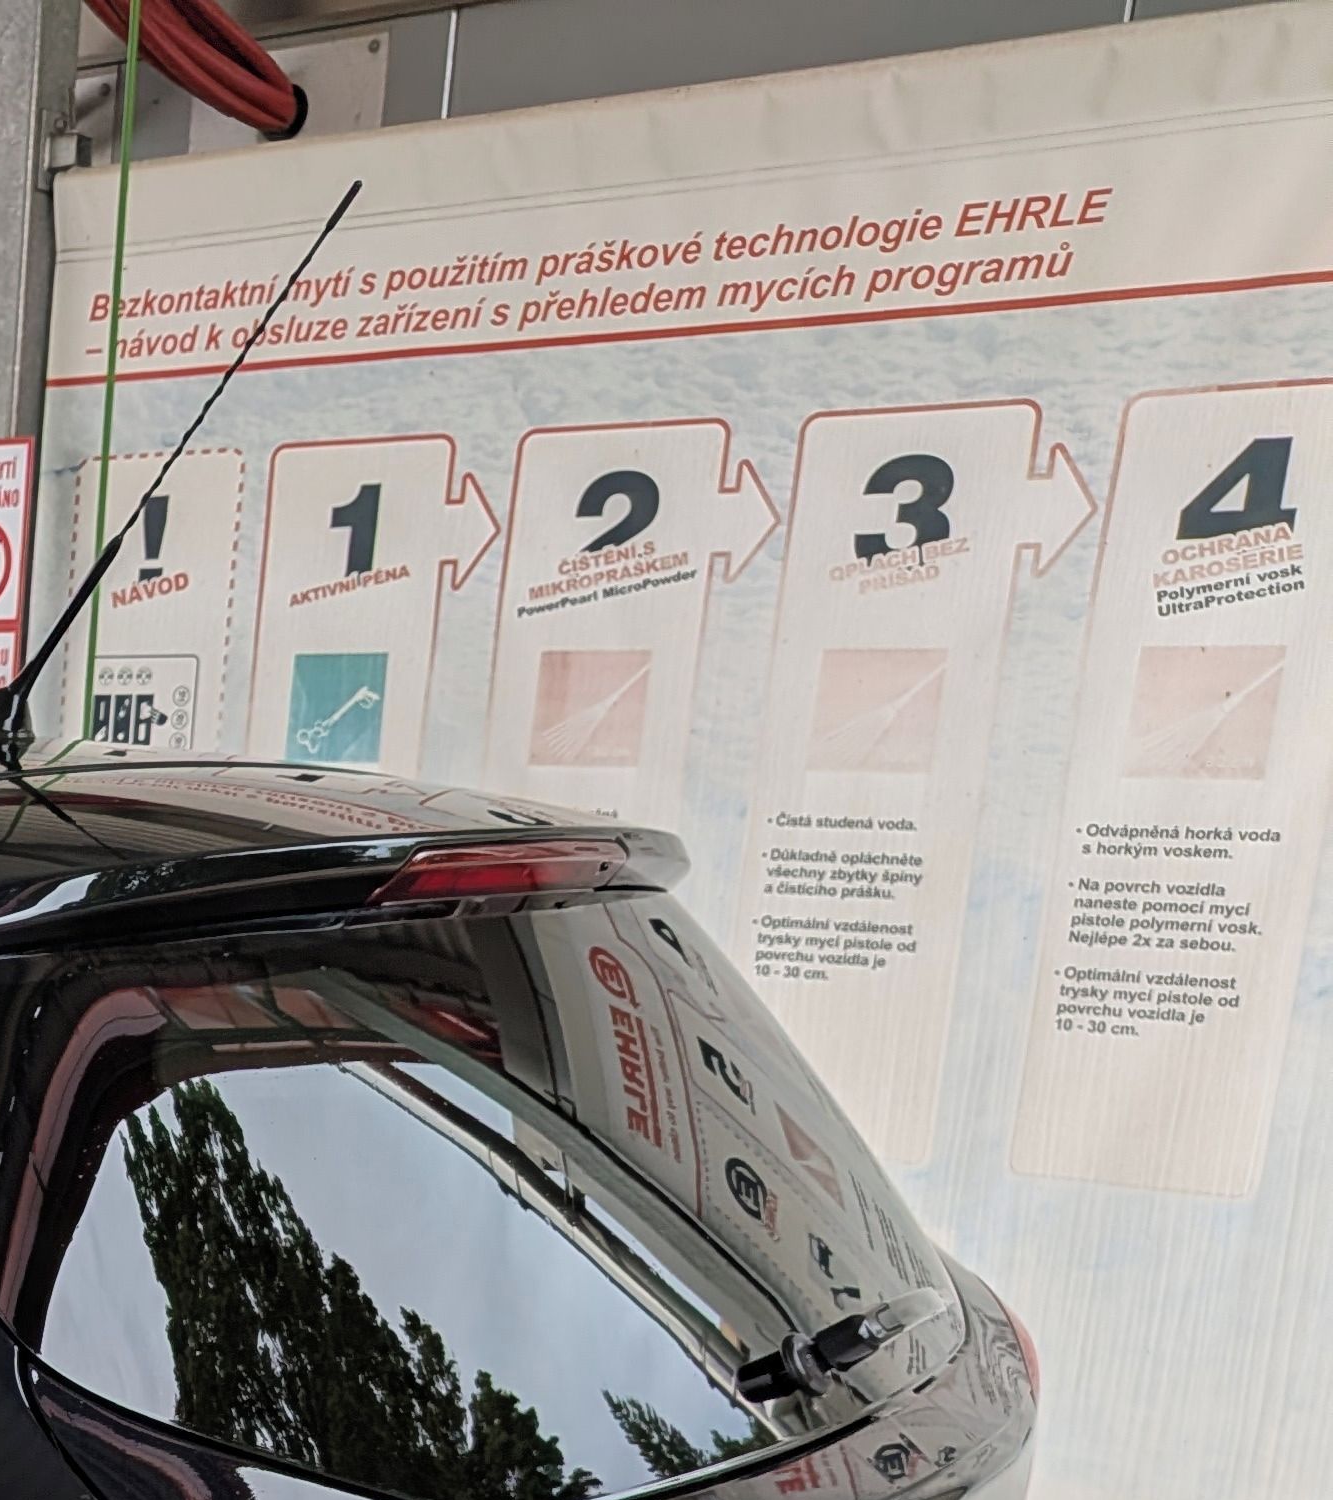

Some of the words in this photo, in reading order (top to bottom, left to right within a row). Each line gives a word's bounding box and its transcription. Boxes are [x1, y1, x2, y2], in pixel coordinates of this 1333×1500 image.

[89, 274, 279, 322] Bezkontaktní
[290, 266, 351, 309] mytí
[359, 271, 376, 296] s
[384, 251, 529, 300] použitím
[536, 231, 704, 291] práškové
[713, 207, 943, 262] technologie
[954, 188, 1113, 238] EHRLE
[116, 324, 200, 359] návod
[205, 323, 224, 351] k
[356, 297, 484, 338] zařízení
[490, 306, 509, 326] s
[518, 278, 707, 331] přehledem
[717, 263, 856, 313] mycích
[864, 240, 1075, 303] programů
[1176, 436, 1297, 540] 4
[576, 470, 660, 552] 2
[853, 454, 954, 566] 3
[329, 483, 381, 579] 1
[643, 541, 656, 556] S
[924, 537, 970, 559] BEZ
[1161, 525, 1292, 565] OCHRANA
[517, 590, 599, 618] PowerPearl
[602, 568, 698, 600] MicroPowder
[1156, 572, 1251, 602] Polymerní
[1257, 564, 1303, 582] vosk
[1157, 580, 1305, 617] UltraProtection
[775, 812, 812, 827] Čistá
[816, 815, 873, 830] studená
[877, 817, 918, 831] voda.
[1085, 823, 1180, 841] Odvápněná
[1184, 826, 1233, 841] horká
[1238, 828, 1281, 842] voda
[770, 848, 837, 863] Důkladně
[841, 852, 923, 867] opláchněte
[1081, 842, 1092, 855] s
[1096, 841, 1158, 859] horkým
[1163, 844, 1234, 860] voskem.
[766, 866, 825, 882] všechny
[829, 869, 877, 884] zbytky
[764, 883, 773, 894] a
[1077, 878, 1100, 891] Na
[1104, 880, 1161, 895] povrch
[1166, 882, 1226, 897] vozidla
[1073, 897, 1137, 910] naneste
[1141, 900, 1205, 915] pomocí
[1208, 902, 1251, 918] mycí
[761, 915, 830, 931] Optimální
[833, 919, 913, 936] vzdálenost
[1070, 912, 1125, 928] pistole
[1129, 916, 1213, 932] polymerní
[1217, 921, 1263, 935] vosk.
[757, 932, 801, 948] trysky
[805, 935, 840, 950] mycí
[843, 936, 892, 952] pistole
[897, 940, 917, 953] od
[1068, 930, 1128, 948] Nejlépe
[1133, 933, 1151, 947] 2x
[1155, 937, 1174, 949] za
[1179, 938, 1236, 952] sebou.
[755, 950, 814, 964] povrchu
[818, 951, 869, 966] vozidla
[872, 954, 886, 970] je
[755, 964, 770, 976] 10
[784, 965, 800, 978] 30
[803, 968, 829, 980] cm.
[1064, 966, 1141, 983] Optimální
[1146, 972, 1236, 989] vzdálenost
[1059, 984, 1109, 1000] trysky
[1113, 988, 1153, 1004] mycí
[1157, 990, 1213, 1006] pistole
[1217, 995, 1240, 1007] od
[1056, 1002, 1123, 1017] povrchu
[1128, 1007, 1184, 1022] vozidla
[1189, 1011, 1205, 1025] je
[1055, 1018, 1073, 1031] 10
[1087, 1020, 1107, 1034] 30
[1110, 1023, 1139, 1036] cm.
